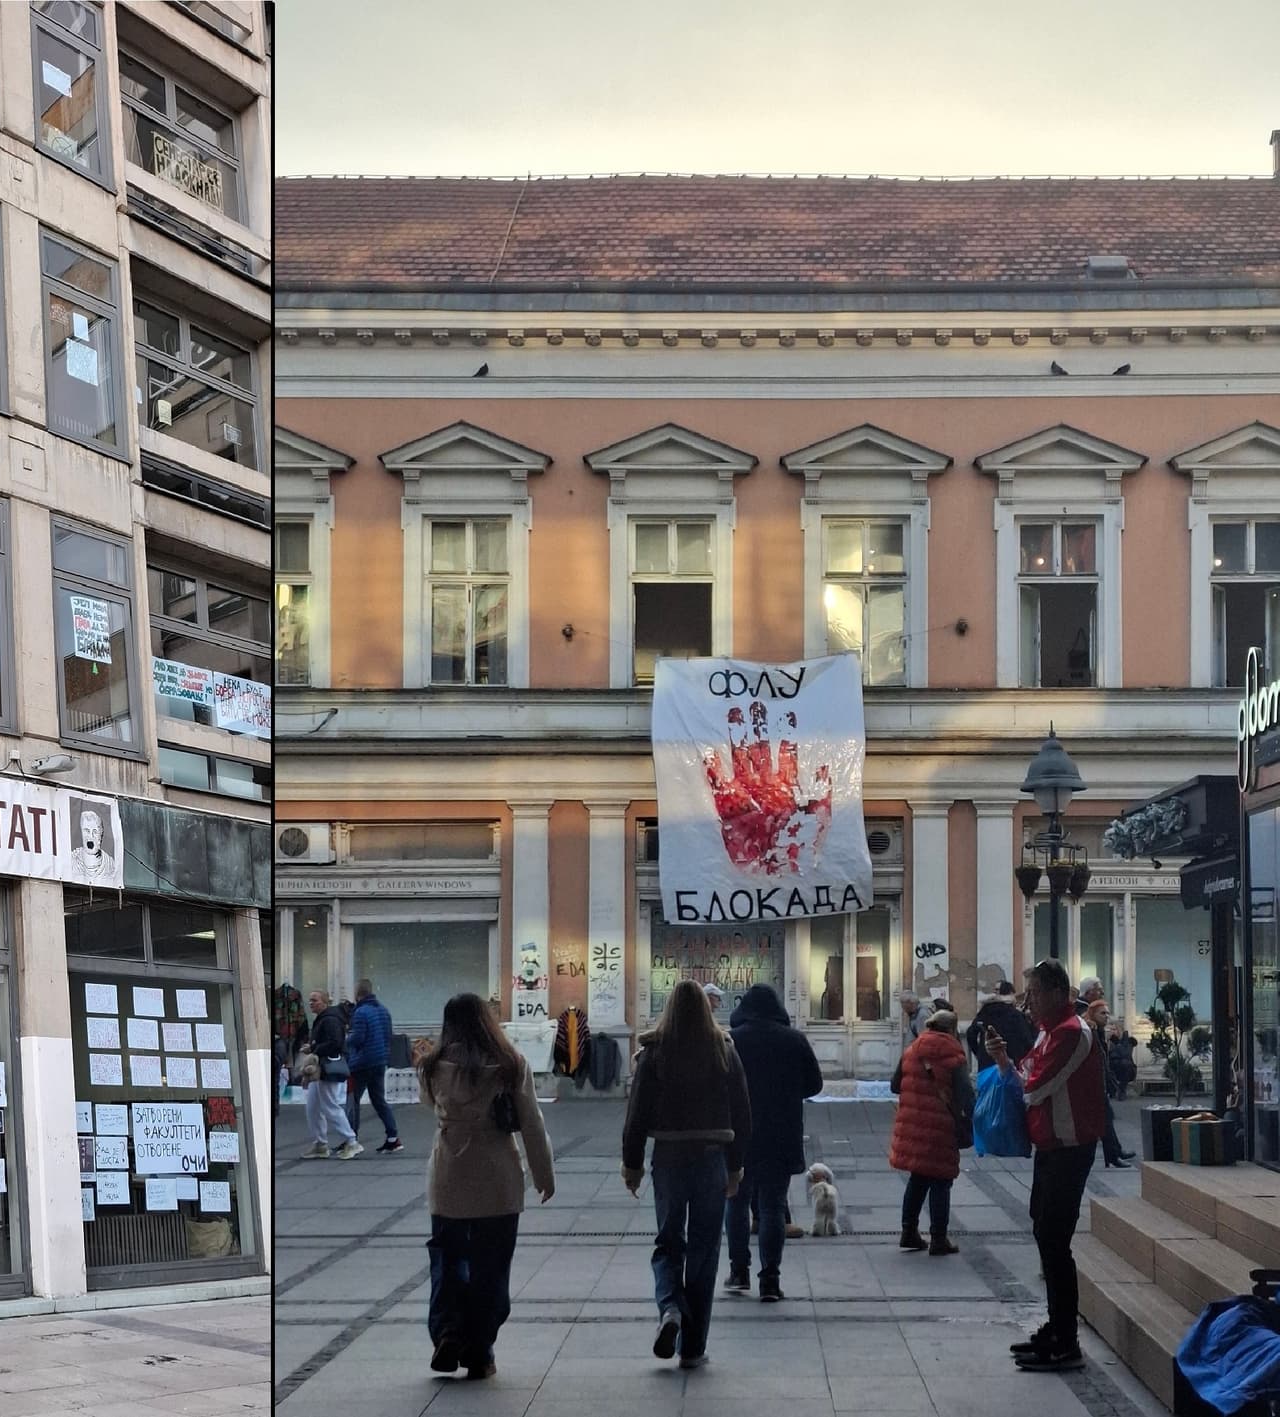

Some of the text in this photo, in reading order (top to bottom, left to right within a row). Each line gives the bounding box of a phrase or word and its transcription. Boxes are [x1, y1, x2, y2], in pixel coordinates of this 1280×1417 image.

[708, 667, 806, 699] ФЛУ
[675, 884, 863, 922] БЛОКАДА
[557, 961, 586, 977] EDA
[517, 1003, 548, 1016] EDA
[135, 1107, 183, 1124] ЗАТВОРЕНИ
[144, 1124, 201, 1140] ФАКУЛТЕТИ
[137, 1143, 182, 1158] ОТВОРЕНЕ
[182, 1155, 206, 1172] ОЧИ
